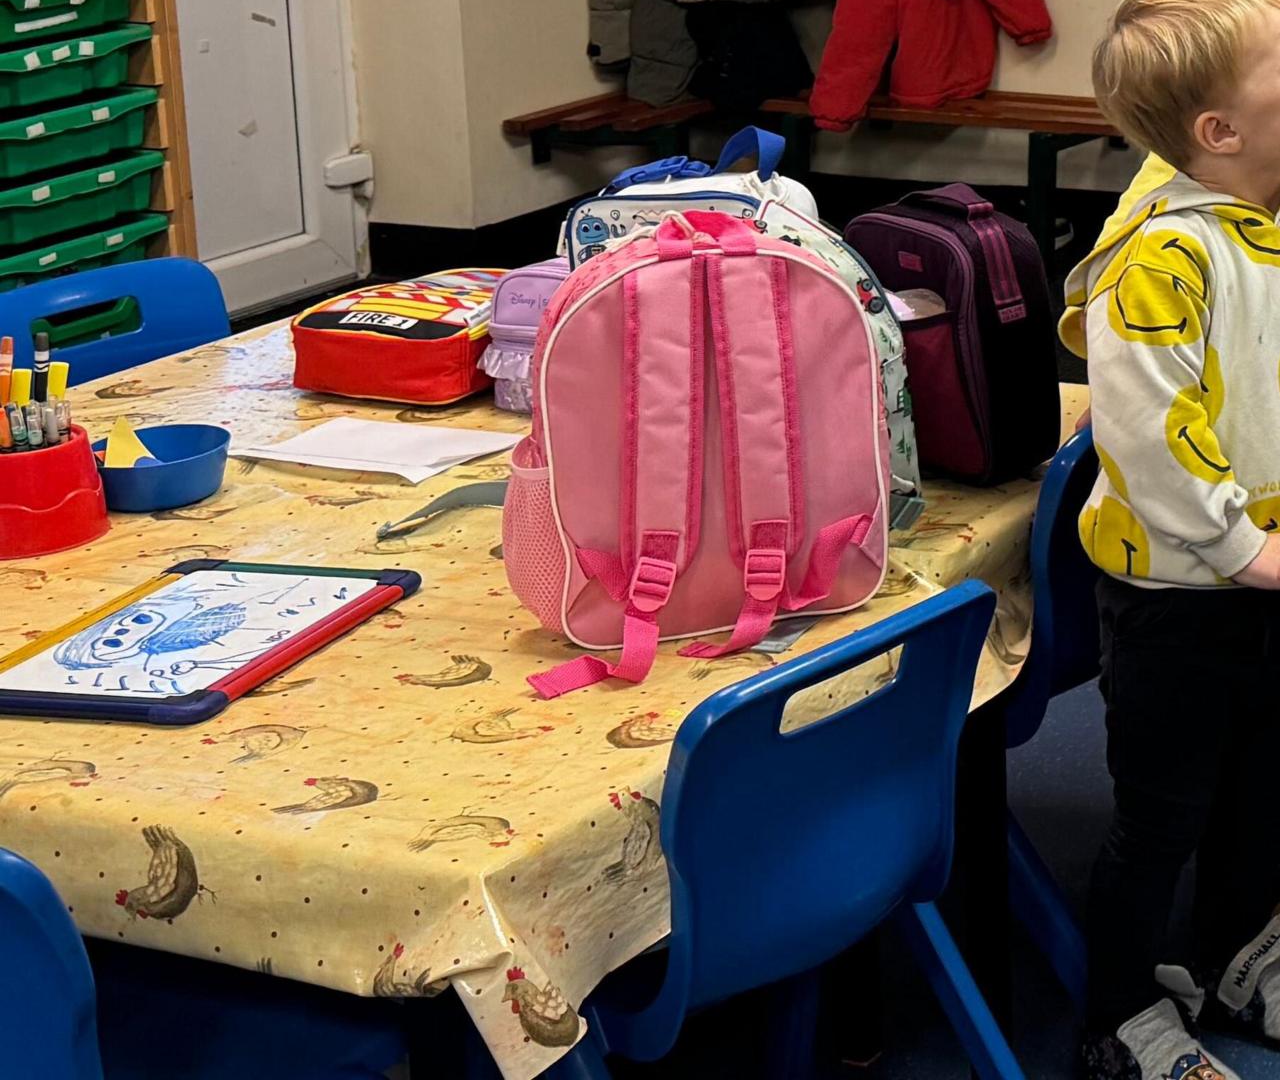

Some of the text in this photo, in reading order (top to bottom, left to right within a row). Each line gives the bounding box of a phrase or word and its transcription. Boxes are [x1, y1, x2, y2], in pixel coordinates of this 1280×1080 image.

[509, 292, 536, 309] Disney
[350, 312, 394, 326] FIRE
[1234, 934, 1280, 988] MARSHALL
